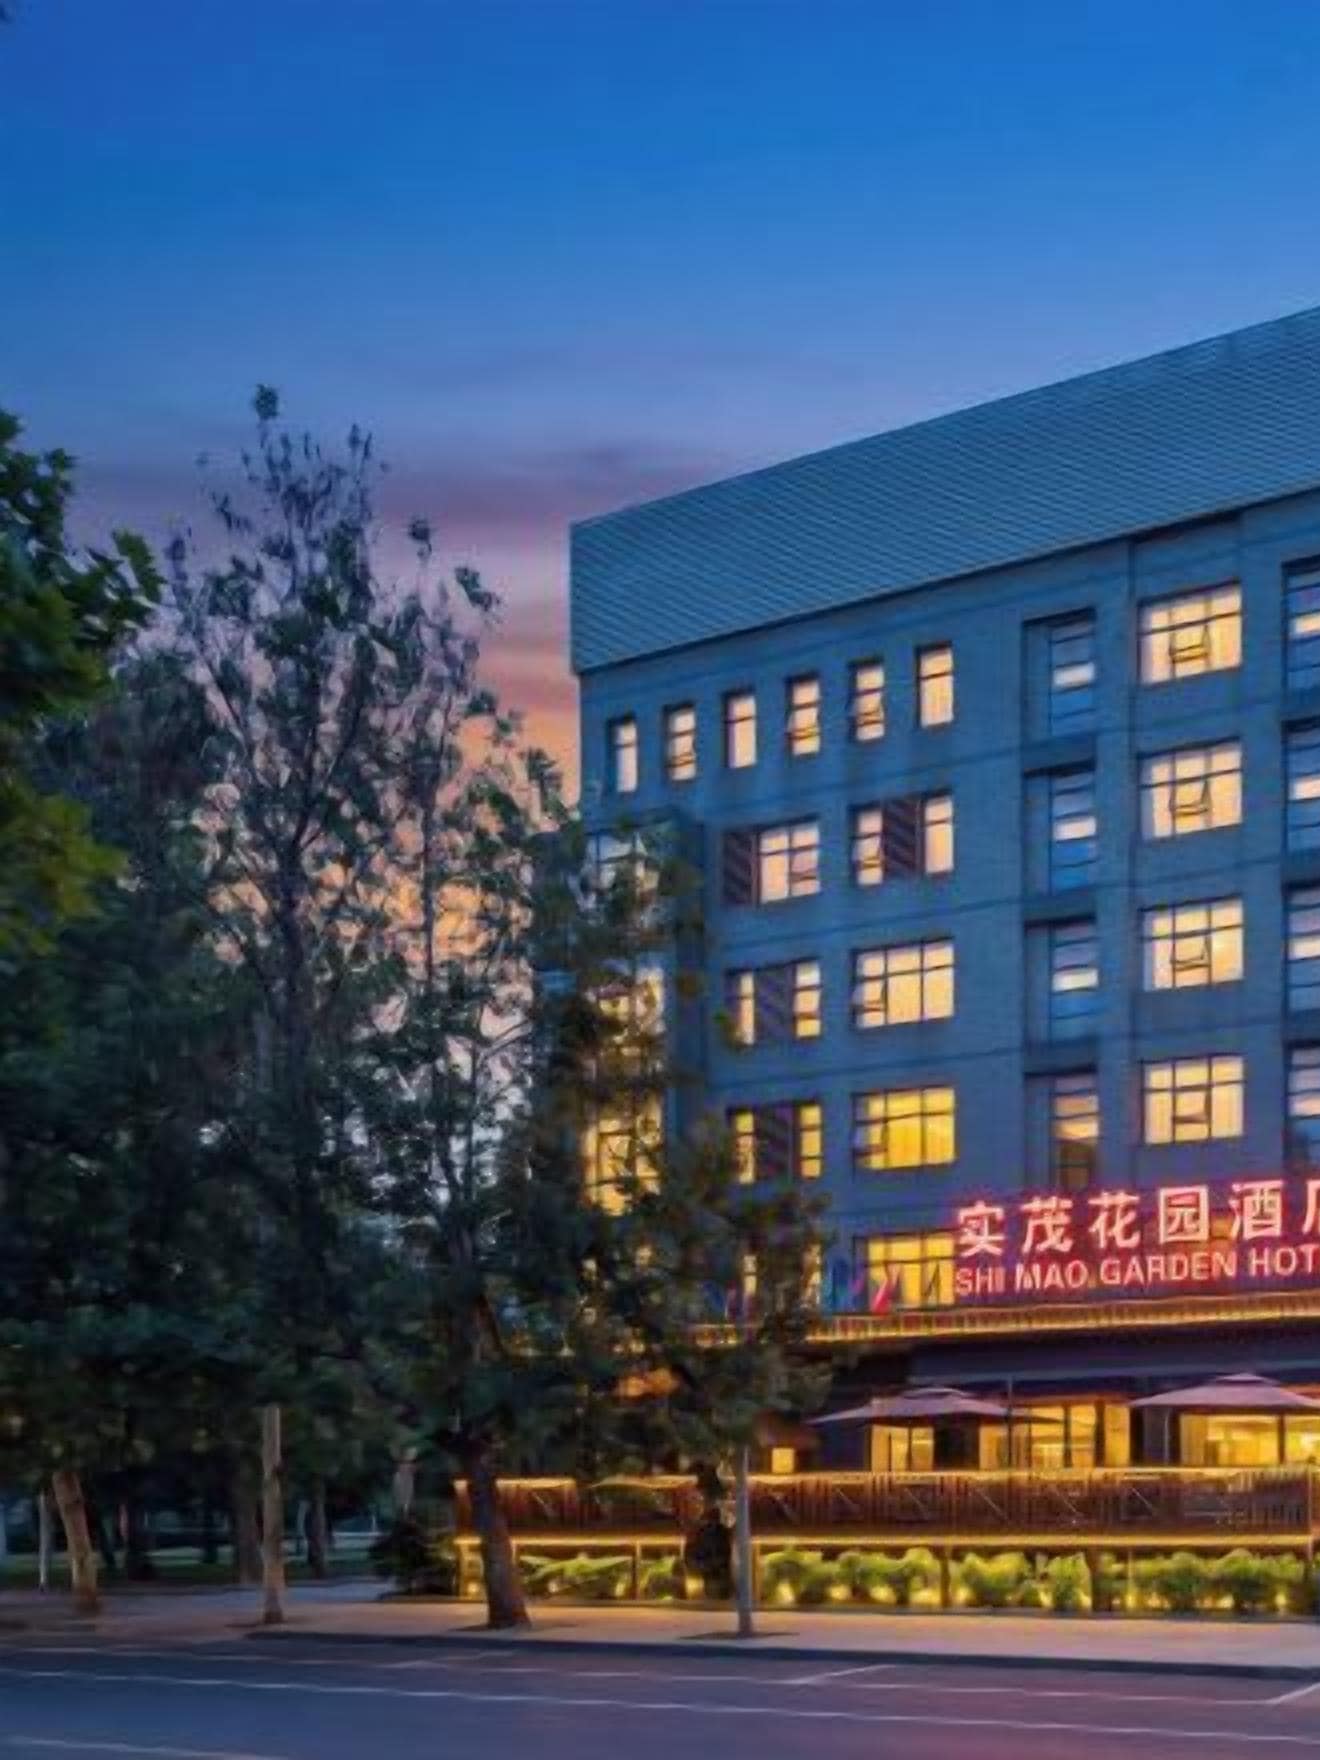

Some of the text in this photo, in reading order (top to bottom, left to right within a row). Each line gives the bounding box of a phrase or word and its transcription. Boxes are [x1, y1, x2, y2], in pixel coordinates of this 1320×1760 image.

[955, 1266, 1005, 1298] SHI
[1016, 1259, 1089, 1291] MAO
[1101, 1248, 1237, 1285] GARDEN
